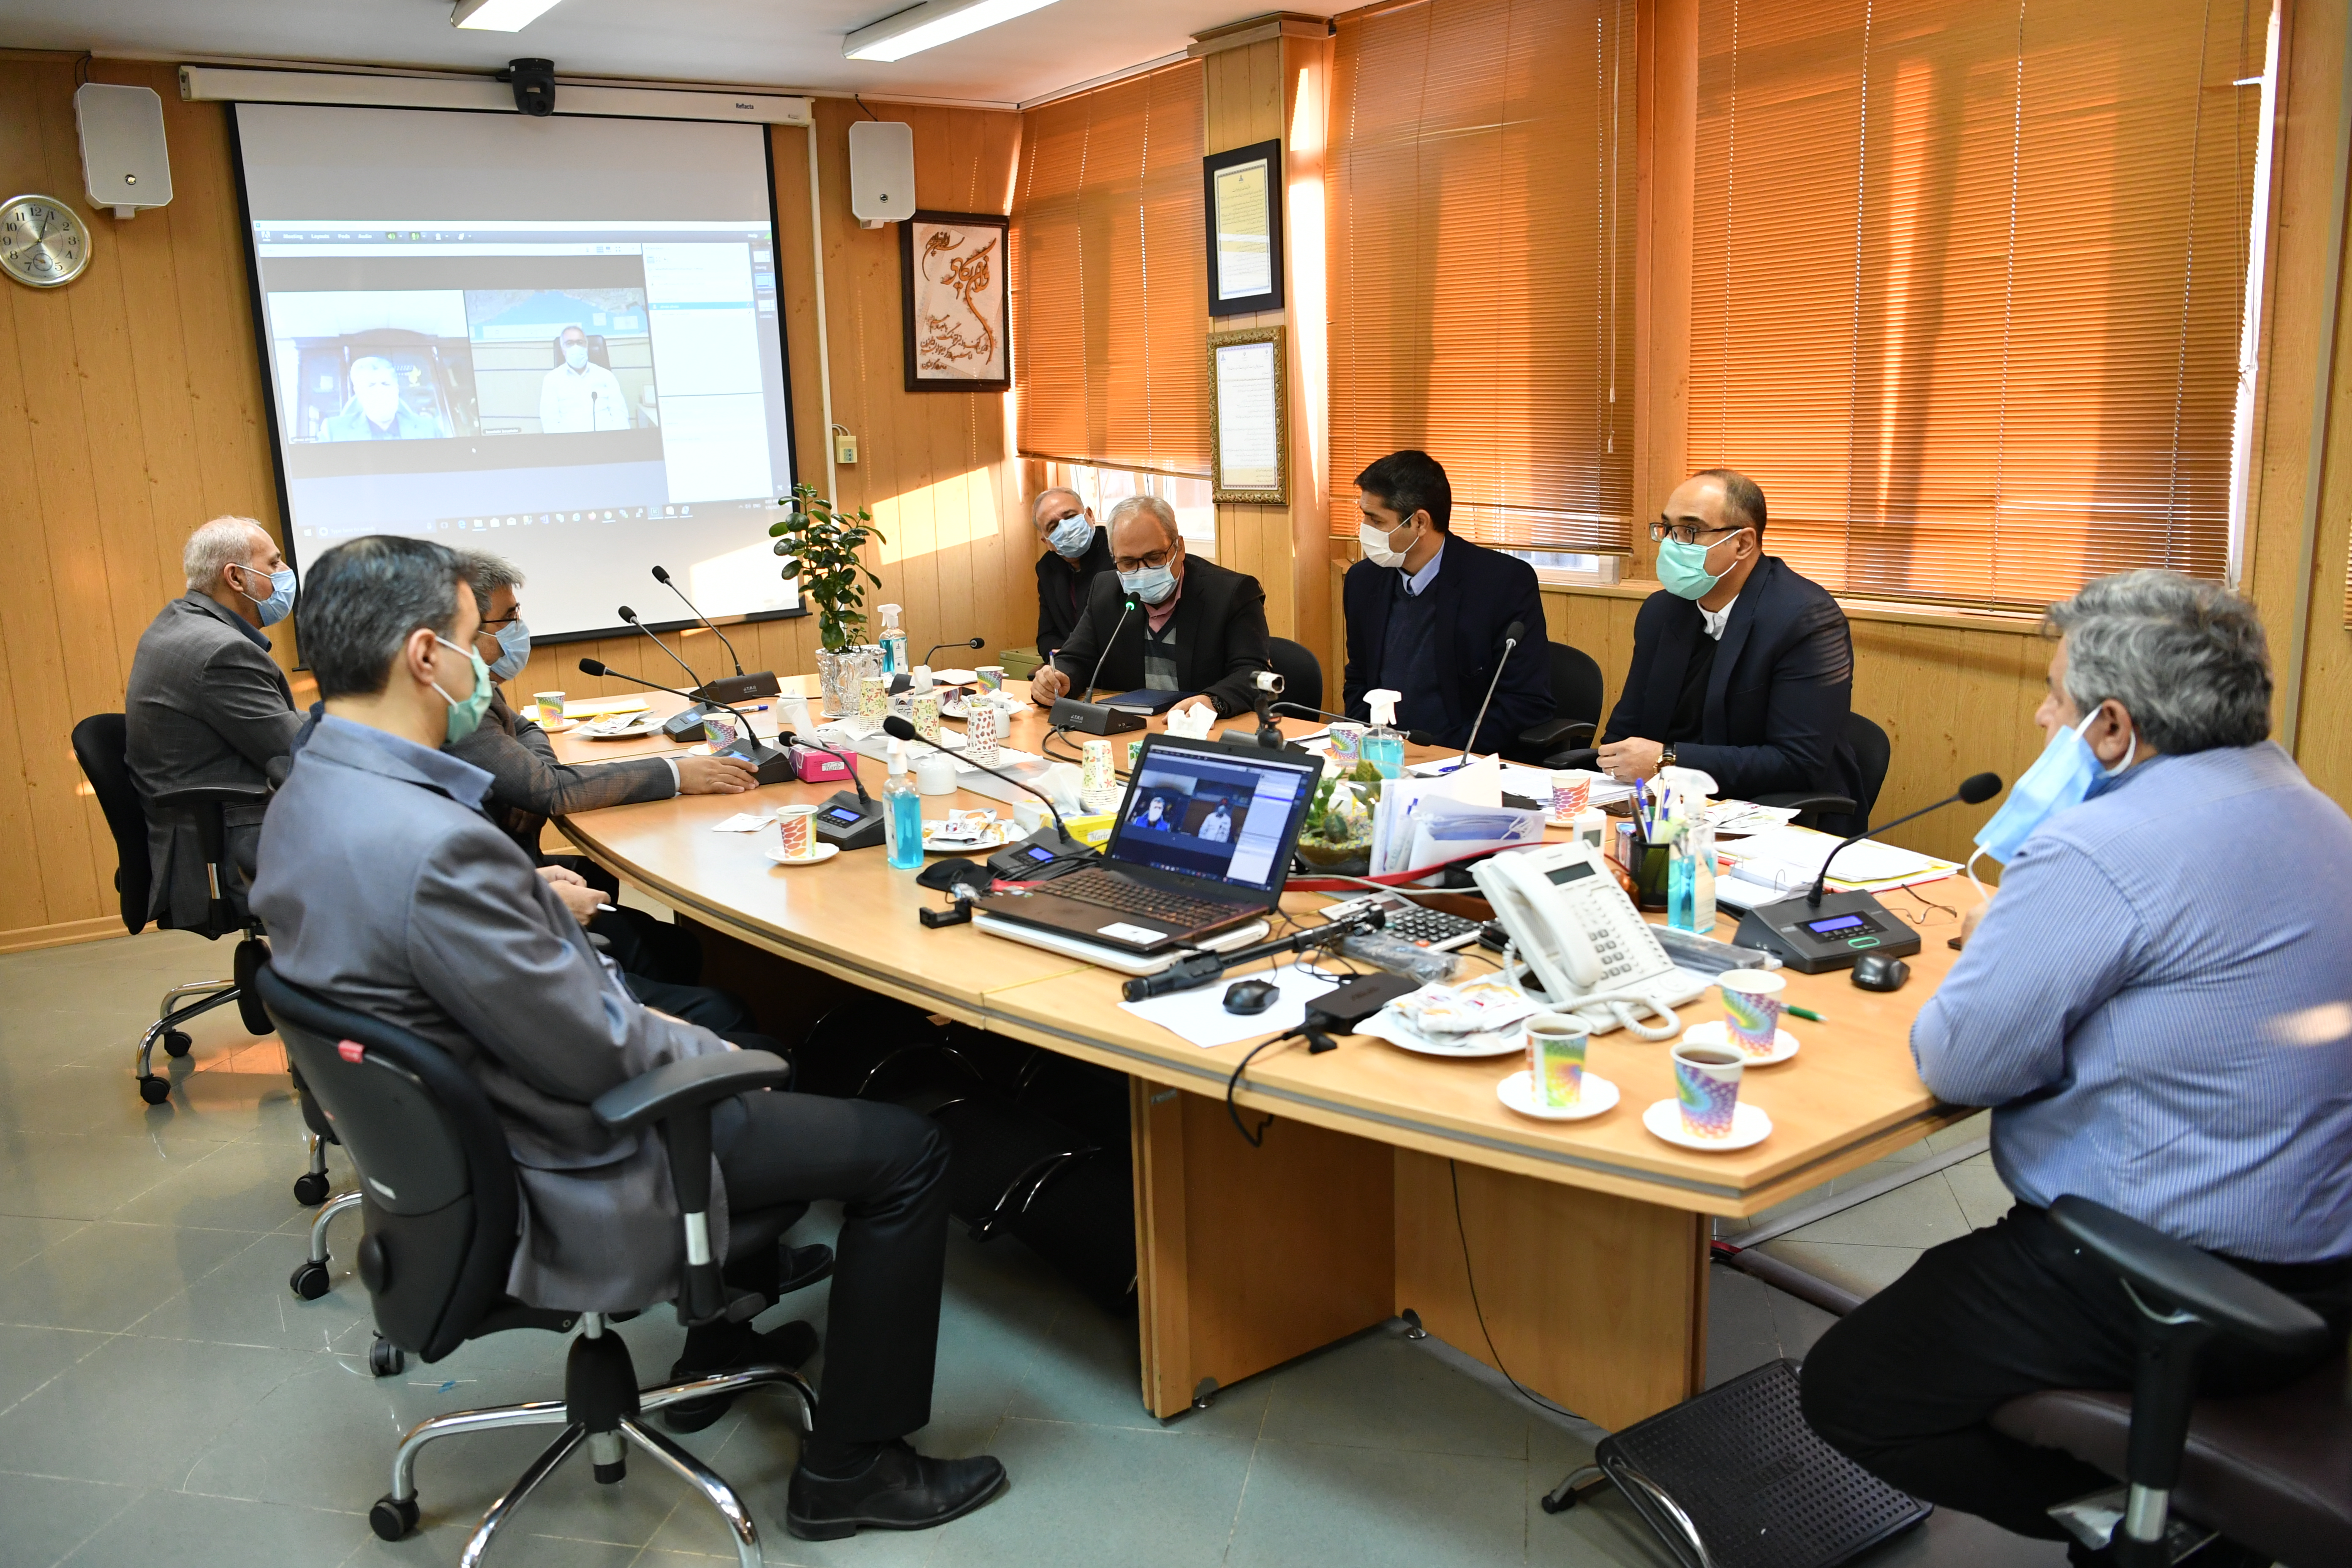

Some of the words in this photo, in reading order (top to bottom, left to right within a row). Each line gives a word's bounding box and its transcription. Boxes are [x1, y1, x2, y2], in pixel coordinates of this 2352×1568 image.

[30, 207, 42, 216] 12
[50, 211, 54, 220] 1
[16, 212, 25, 221] 11
[6, 223, 17, 231] 10
[63, 222, 70, 231] 2
[3, 237, 11, 246] 9
[68, 236, 76, 245] 3
[10, 250, 18, 260] 8
[65, 250, 72, 259] 4
[24, 262, 32, 271] 7
[54, 262, 63, 271] 5
[822, 762, 841, 770] Harir
[1088, 832, 1108, 841] Harir
